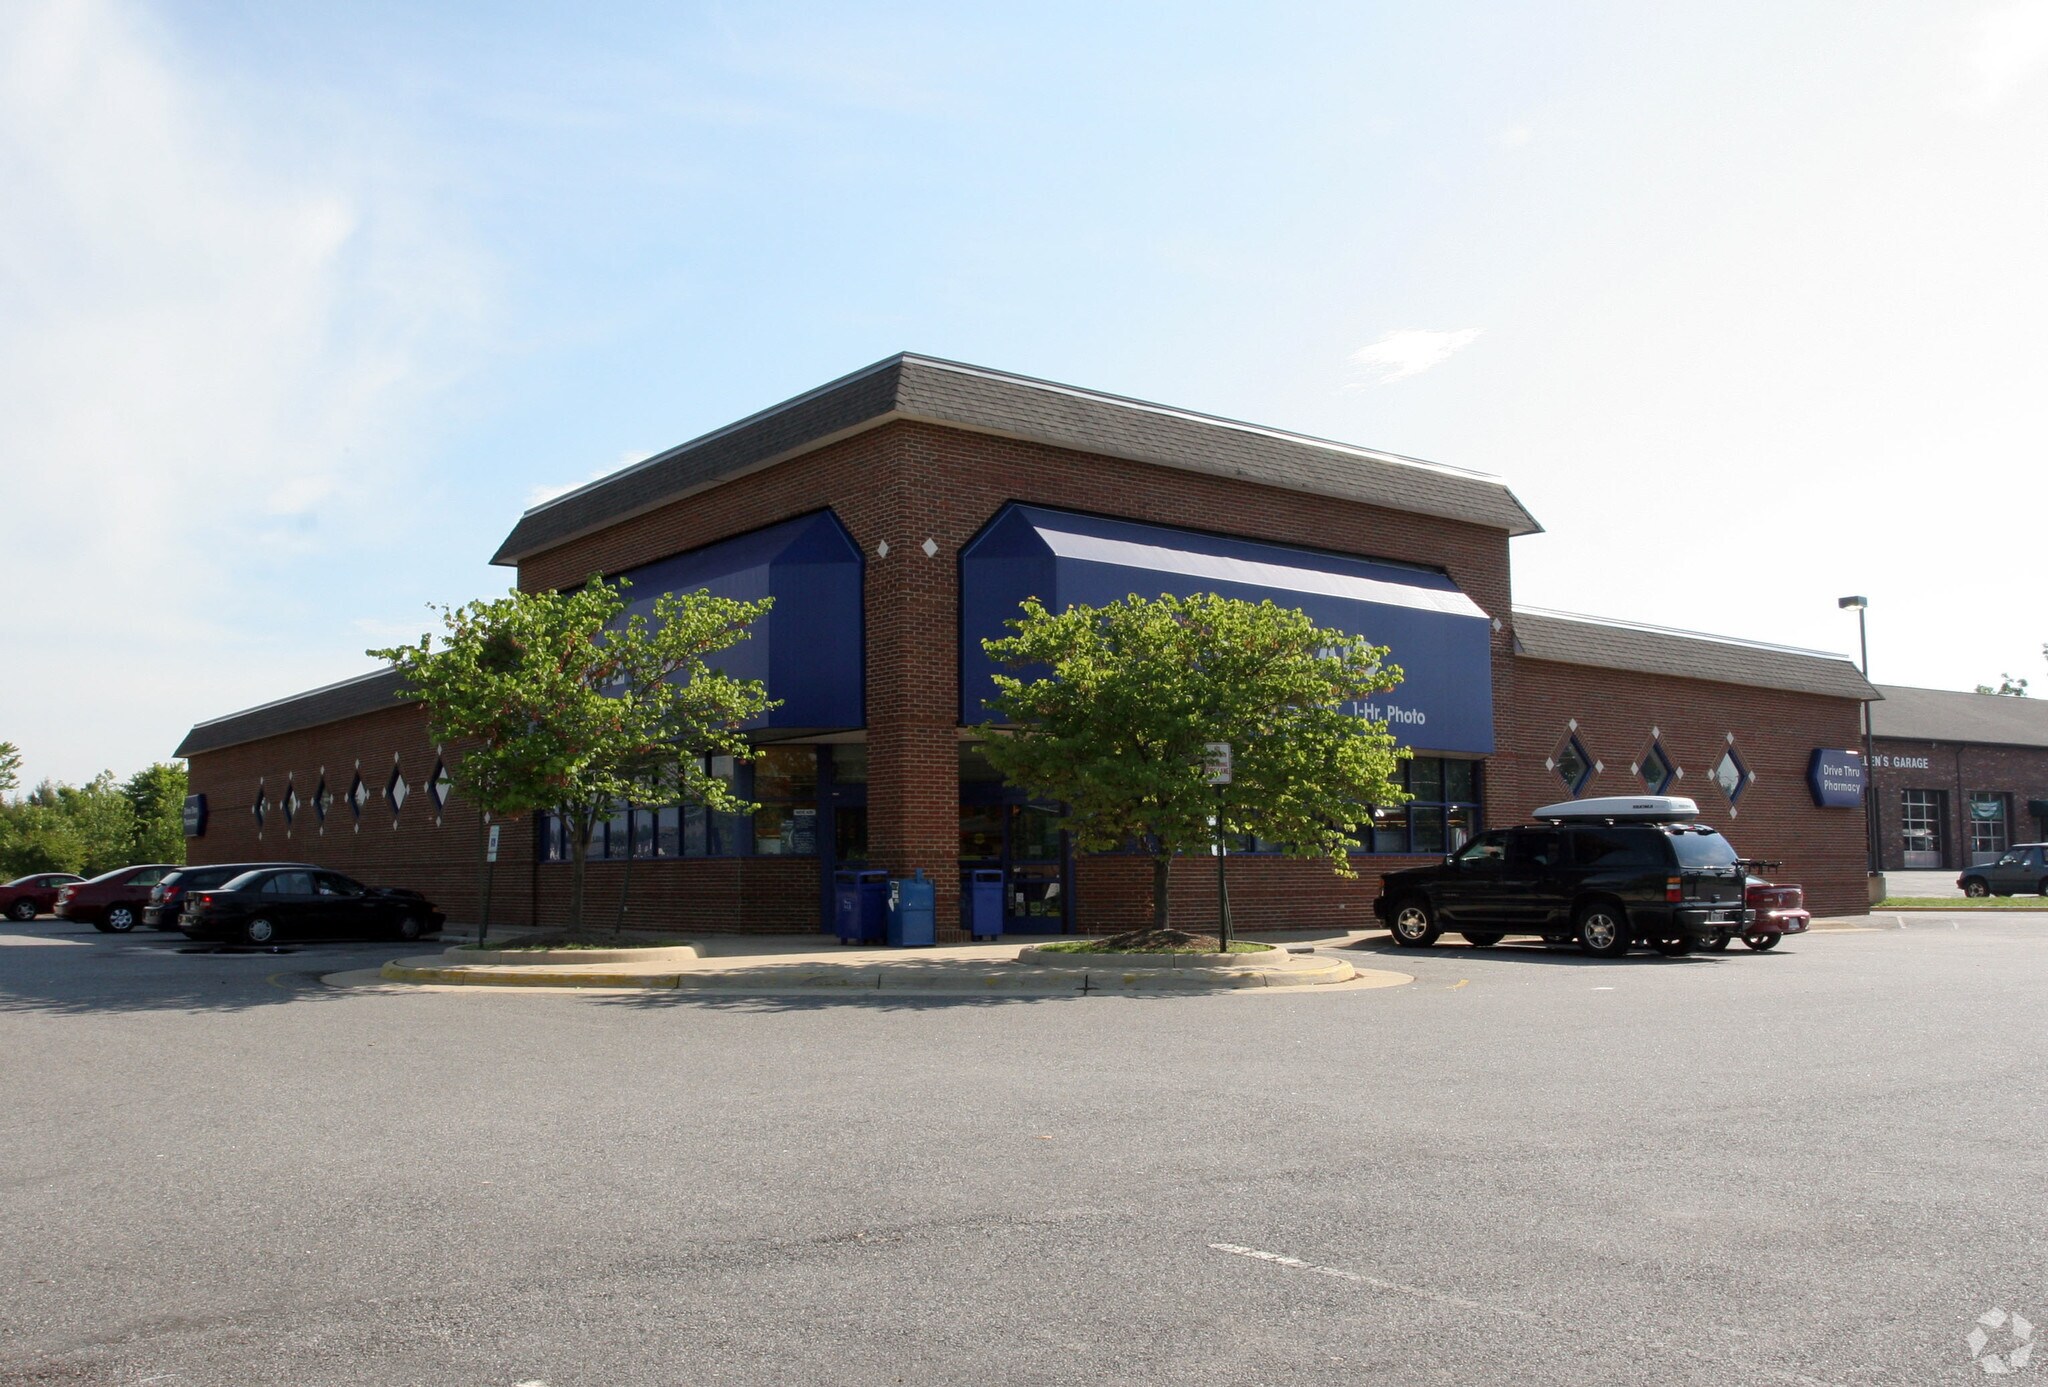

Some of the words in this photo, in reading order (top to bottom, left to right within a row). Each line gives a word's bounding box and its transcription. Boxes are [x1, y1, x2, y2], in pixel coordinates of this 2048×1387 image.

[1353, 702, 1382, 721] 1-Hr.
[1387, 705, 1426, 725] Photo
[1862, 754, 1889, 767] LEN'S
[1893, 756, 1929, 769] GARAGE
[1824, 765, 1842, 776] Drive
[1844, 766, 1860, 777] Thru
[1824, 780, 1860, 794] Pharmacy
